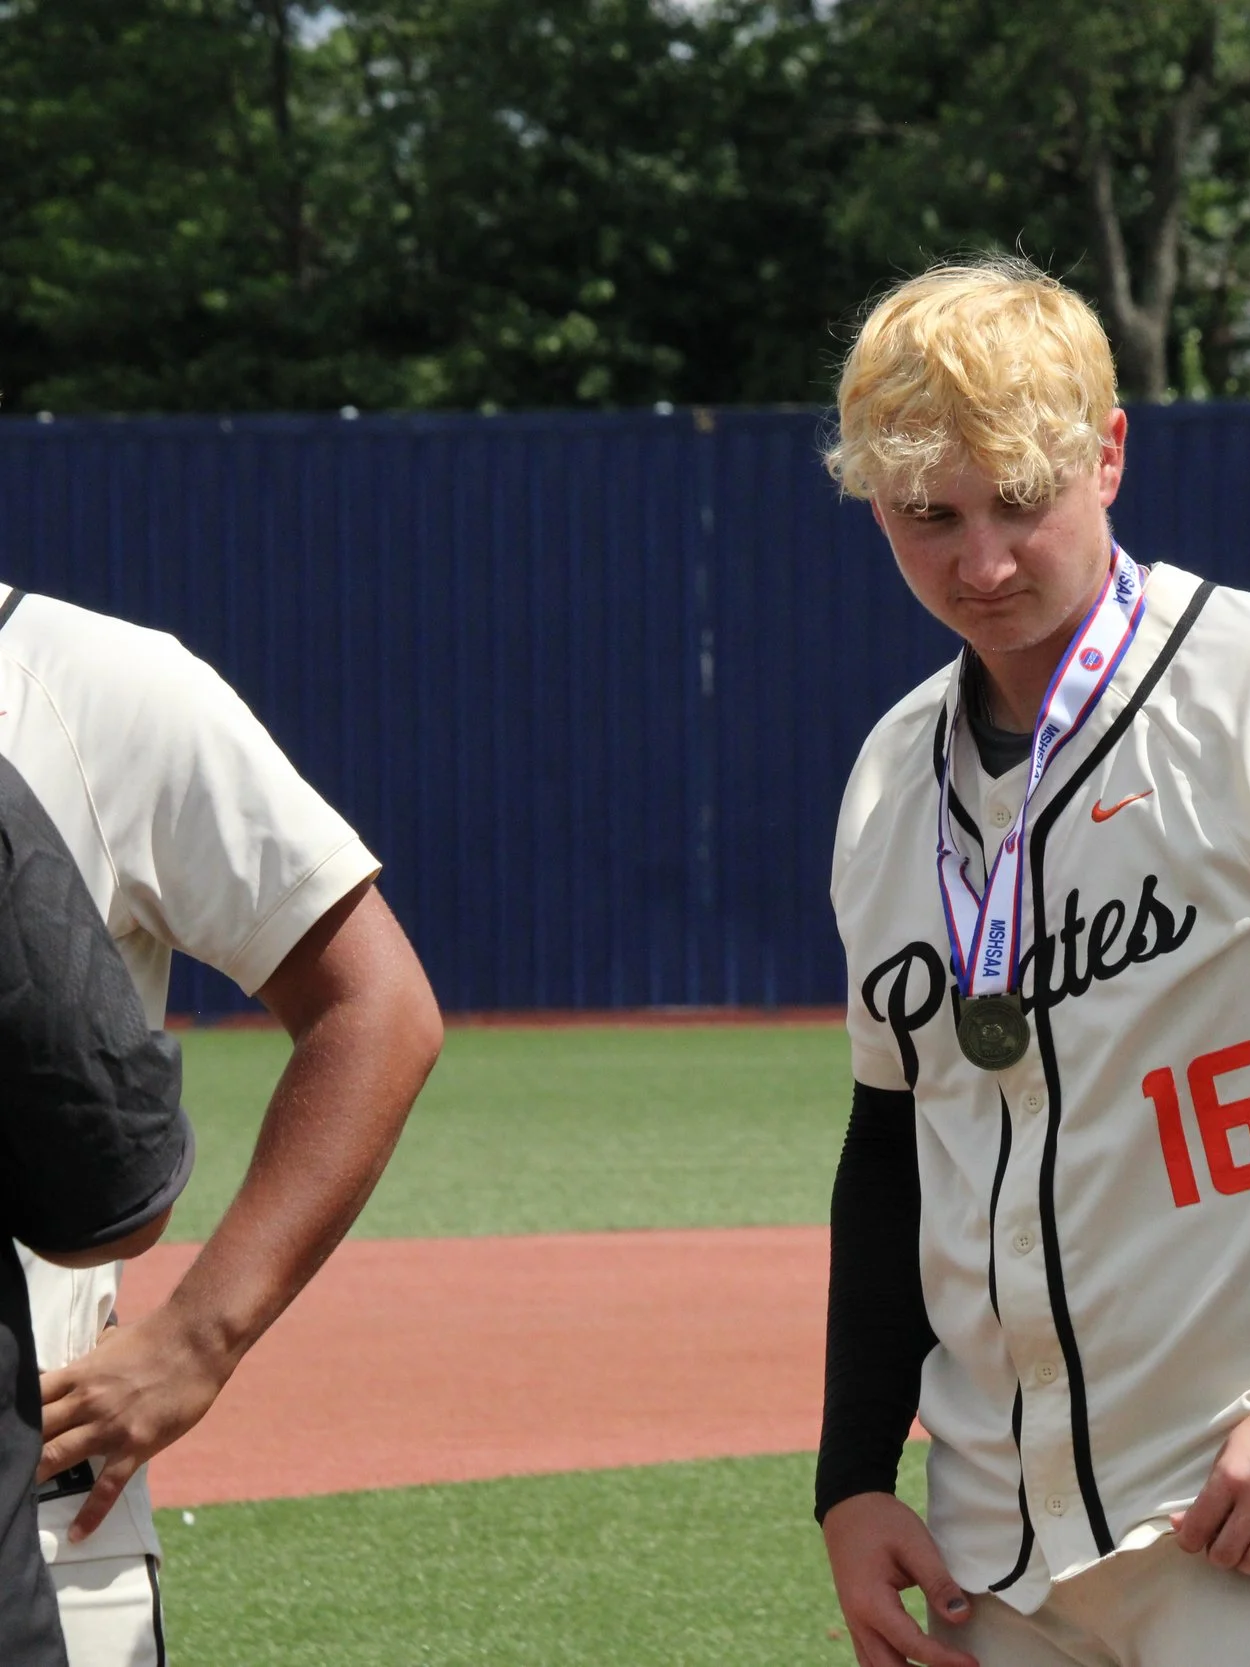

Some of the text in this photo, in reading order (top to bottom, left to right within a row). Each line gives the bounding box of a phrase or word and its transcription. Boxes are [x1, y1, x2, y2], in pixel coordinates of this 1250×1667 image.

[1113, 555, 1136, 605] SAA
[1034, 723, 1060, 779] MSHSAA
[982, 919, 1006, 977] MSHSAA
[861, 874, 1197, 1091] Pates
